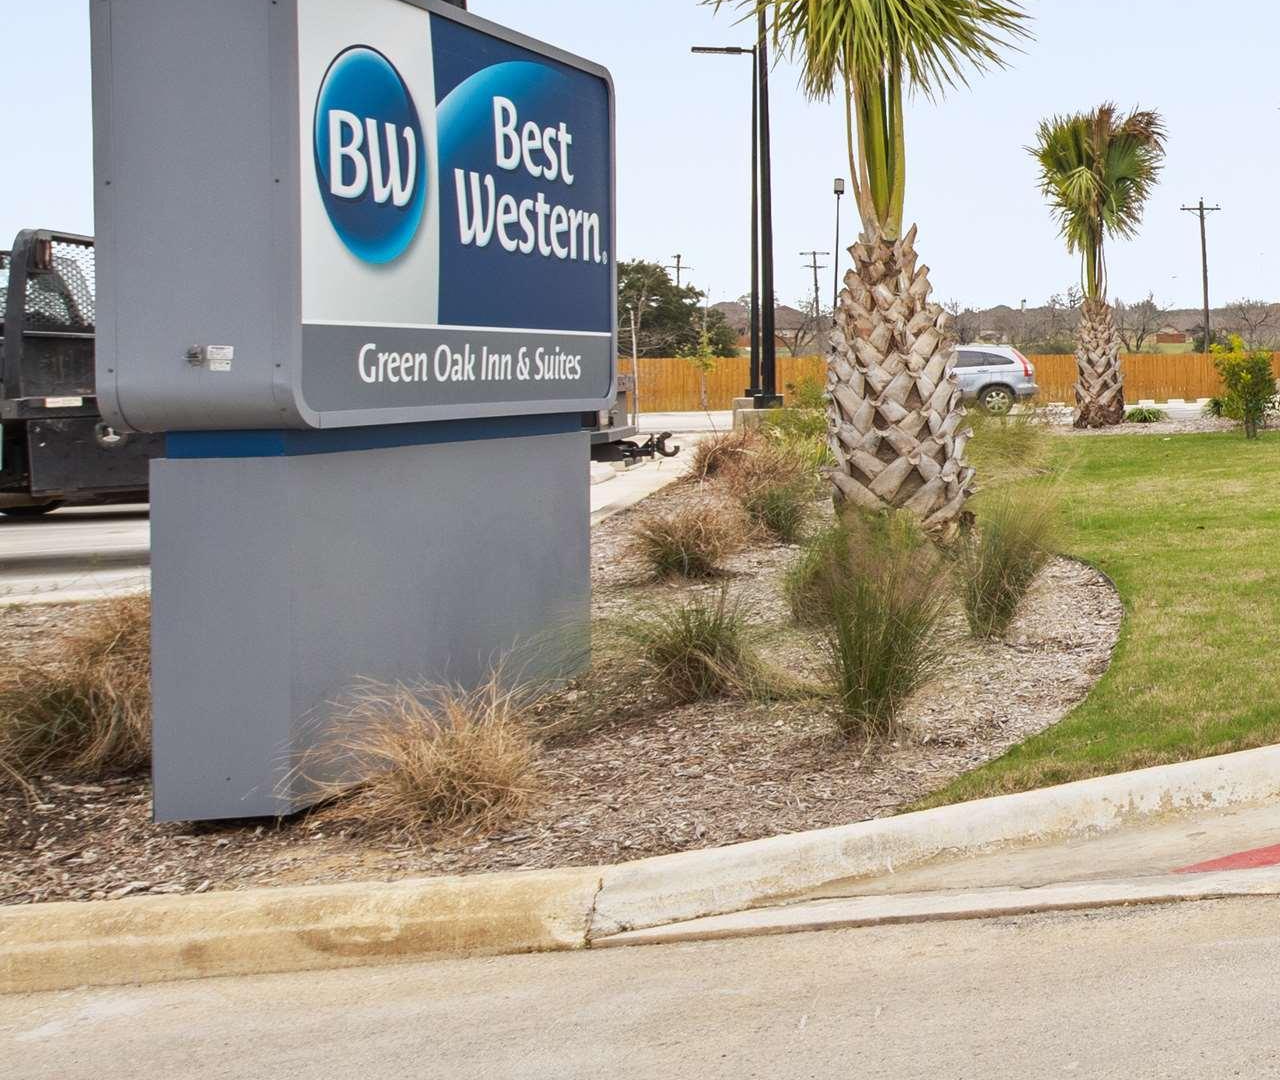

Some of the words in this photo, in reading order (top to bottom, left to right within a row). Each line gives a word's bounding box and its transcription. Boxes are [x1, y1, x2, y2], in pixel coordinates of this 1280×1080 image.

[328, 109, 417, 207] BW
[493, 95, 575, 185] Best
[358, 343, 428, 383] Green
[434, 343, 476, 382] Oak
[481, 346, 512, 381] Inn
[516, 347, 530, 381] &
[534, 346, 582, 380] Suites
